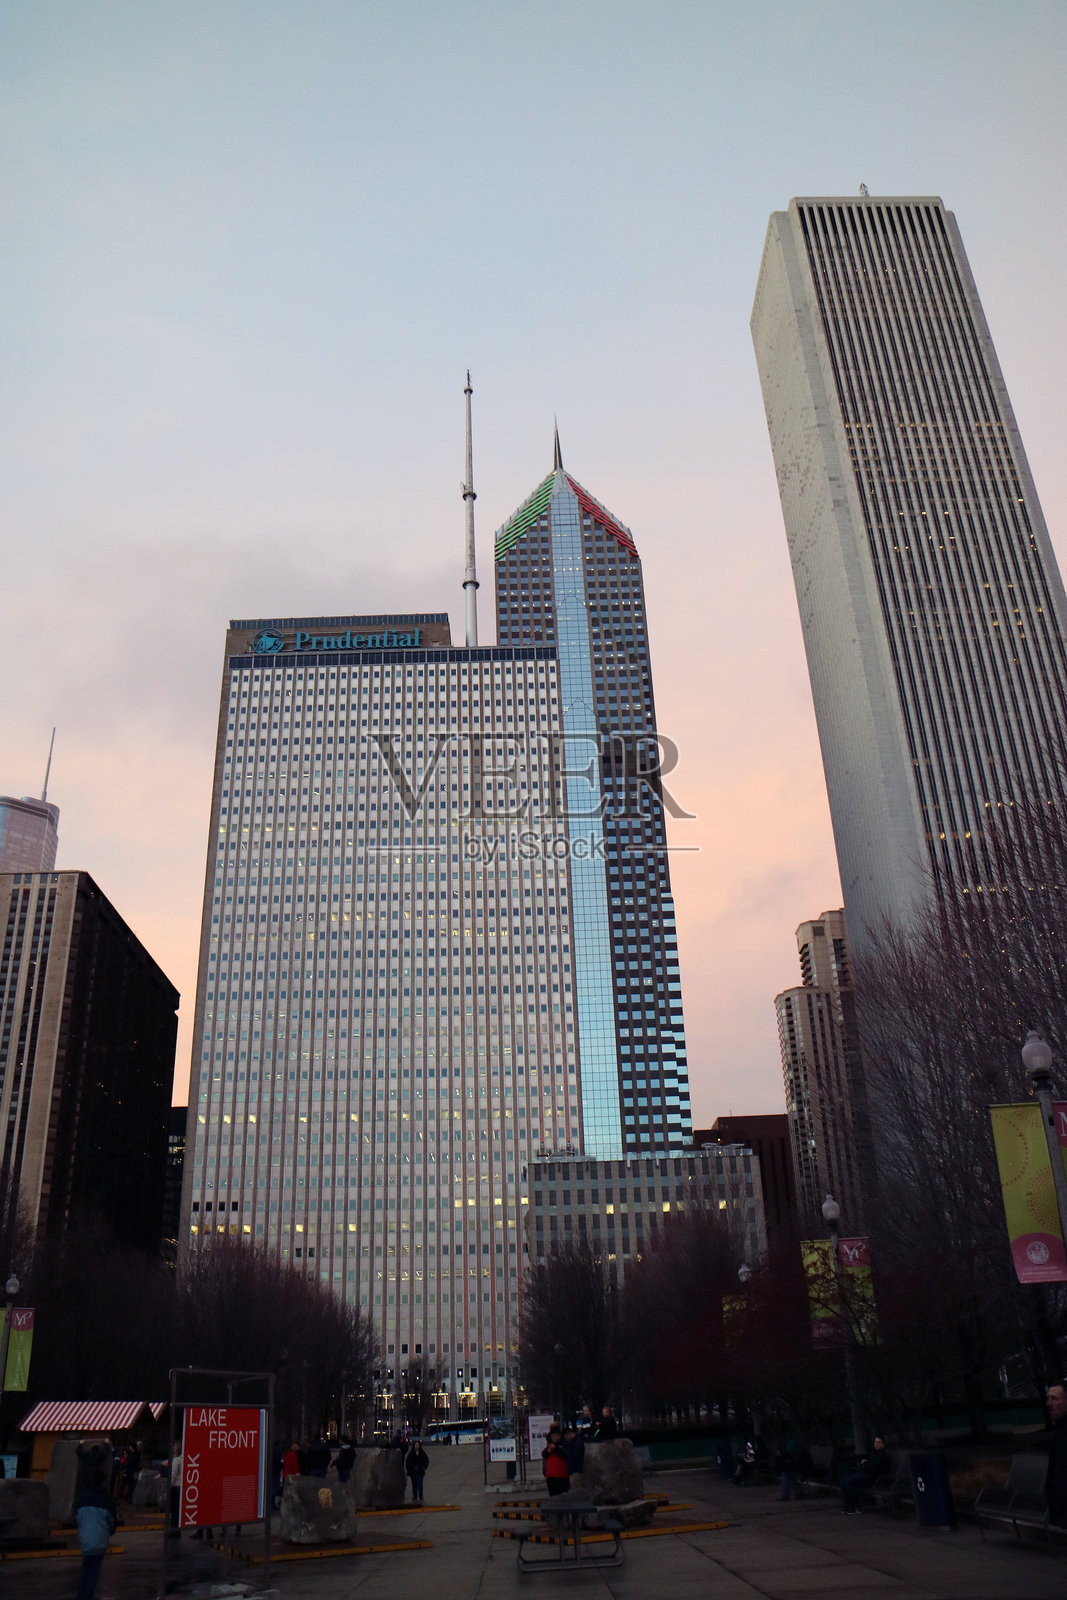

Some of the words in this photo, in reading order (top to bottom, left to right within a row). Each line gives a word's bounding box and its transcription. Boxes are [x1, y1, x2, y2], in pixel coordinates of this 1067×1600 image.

[295, 628, 420, 650] Prudential
[189, 1408, 227, 1427] LAKE
[209, 1430, 258, 1449] FRONT
[184, 1453, 200, 1526] KIOSK
